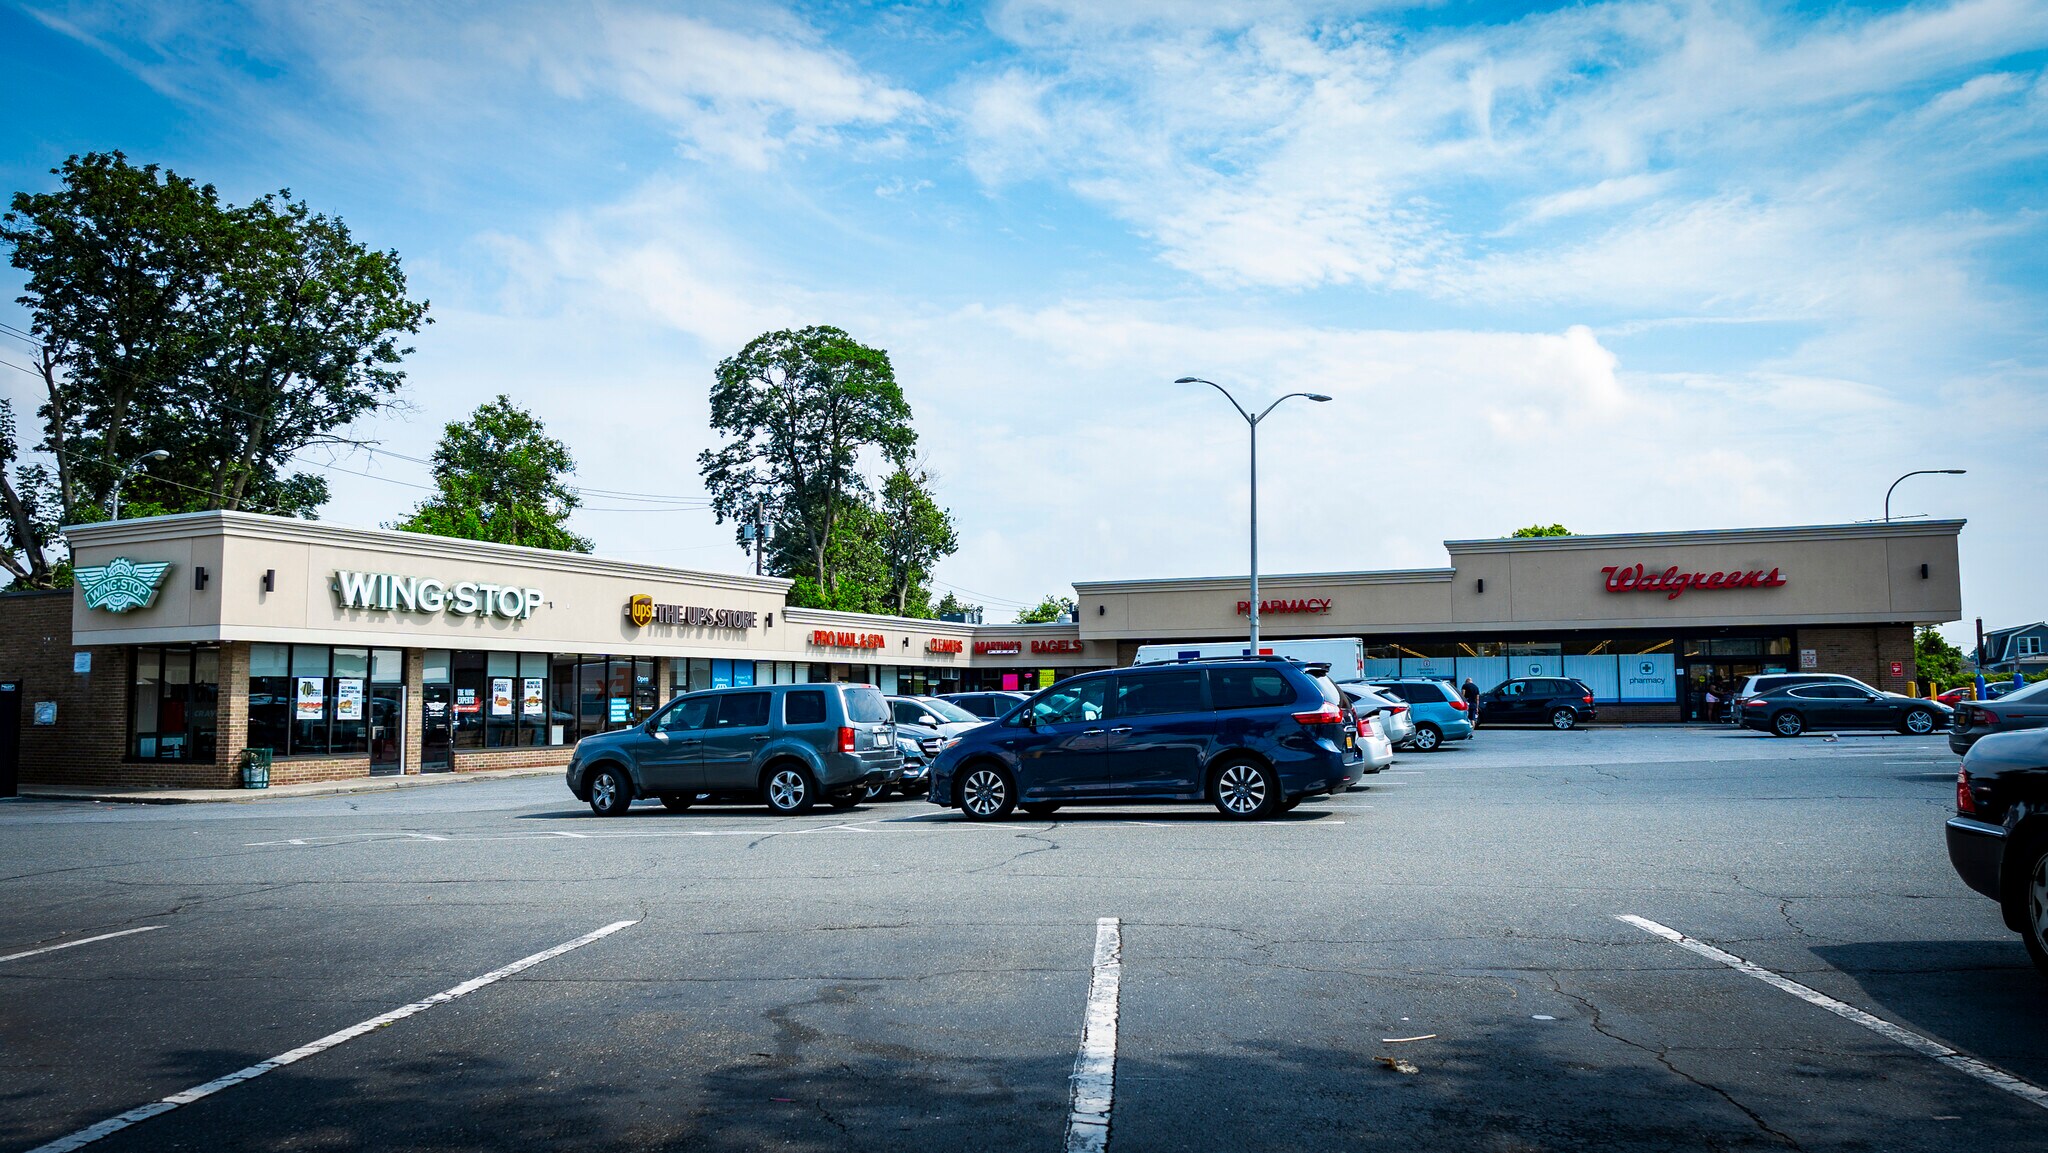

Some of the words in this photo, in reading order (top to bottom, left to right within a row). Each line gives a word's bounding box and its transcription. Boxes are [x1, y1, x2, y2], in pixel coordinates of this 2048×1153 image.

[1601, 563, 1787, 600] Walgreens
[634, 603, 652, 622] ups
[655, 604, 684, 624] THE
[685, 606, 714, 626] UPS
[716, 608, 757, 628] STORE
[813, 630, 835, 647] PRO
[836, 632, 858, 648] NAIL
[860, 633, 867, 648] &
[867, 634, 885, 648] SPA
[1031, 640, 1082, 654] BAGELS
[1629, 677, 1666, 685] pharmacy
